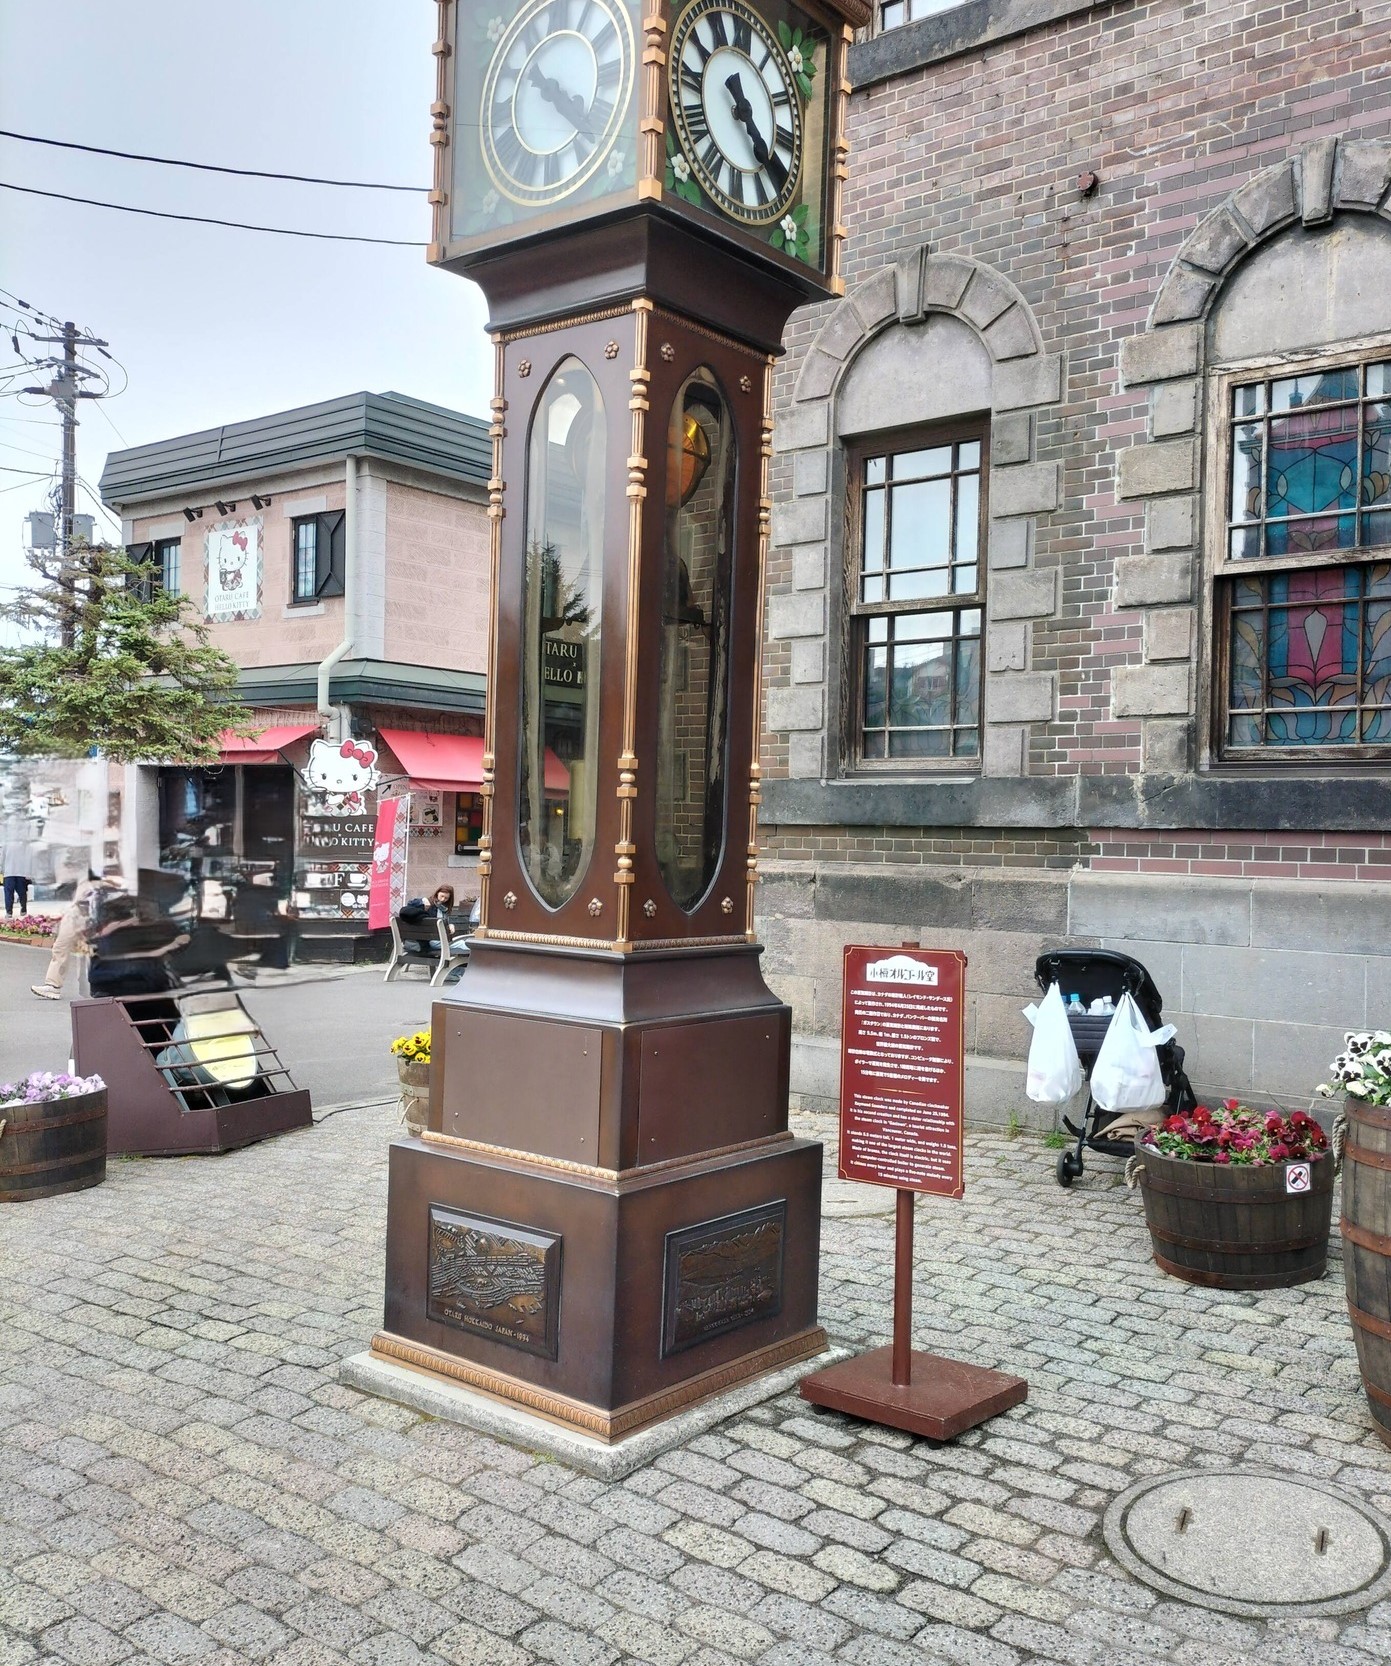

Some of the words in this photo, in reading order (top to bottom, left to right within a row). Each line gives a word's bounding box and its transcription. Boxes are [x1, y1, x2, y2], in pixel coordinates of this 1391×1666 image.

[214, 594, 233, 602] OTARU
[214, 602, 232, 611] HELLO
[232, 601, 250, 609] KITTY
[344, 823, 374, 833] CAFE
[341, 837, 375, 847] KITTY
[870, 967, 936, 982] 小樽オルゴール堂
